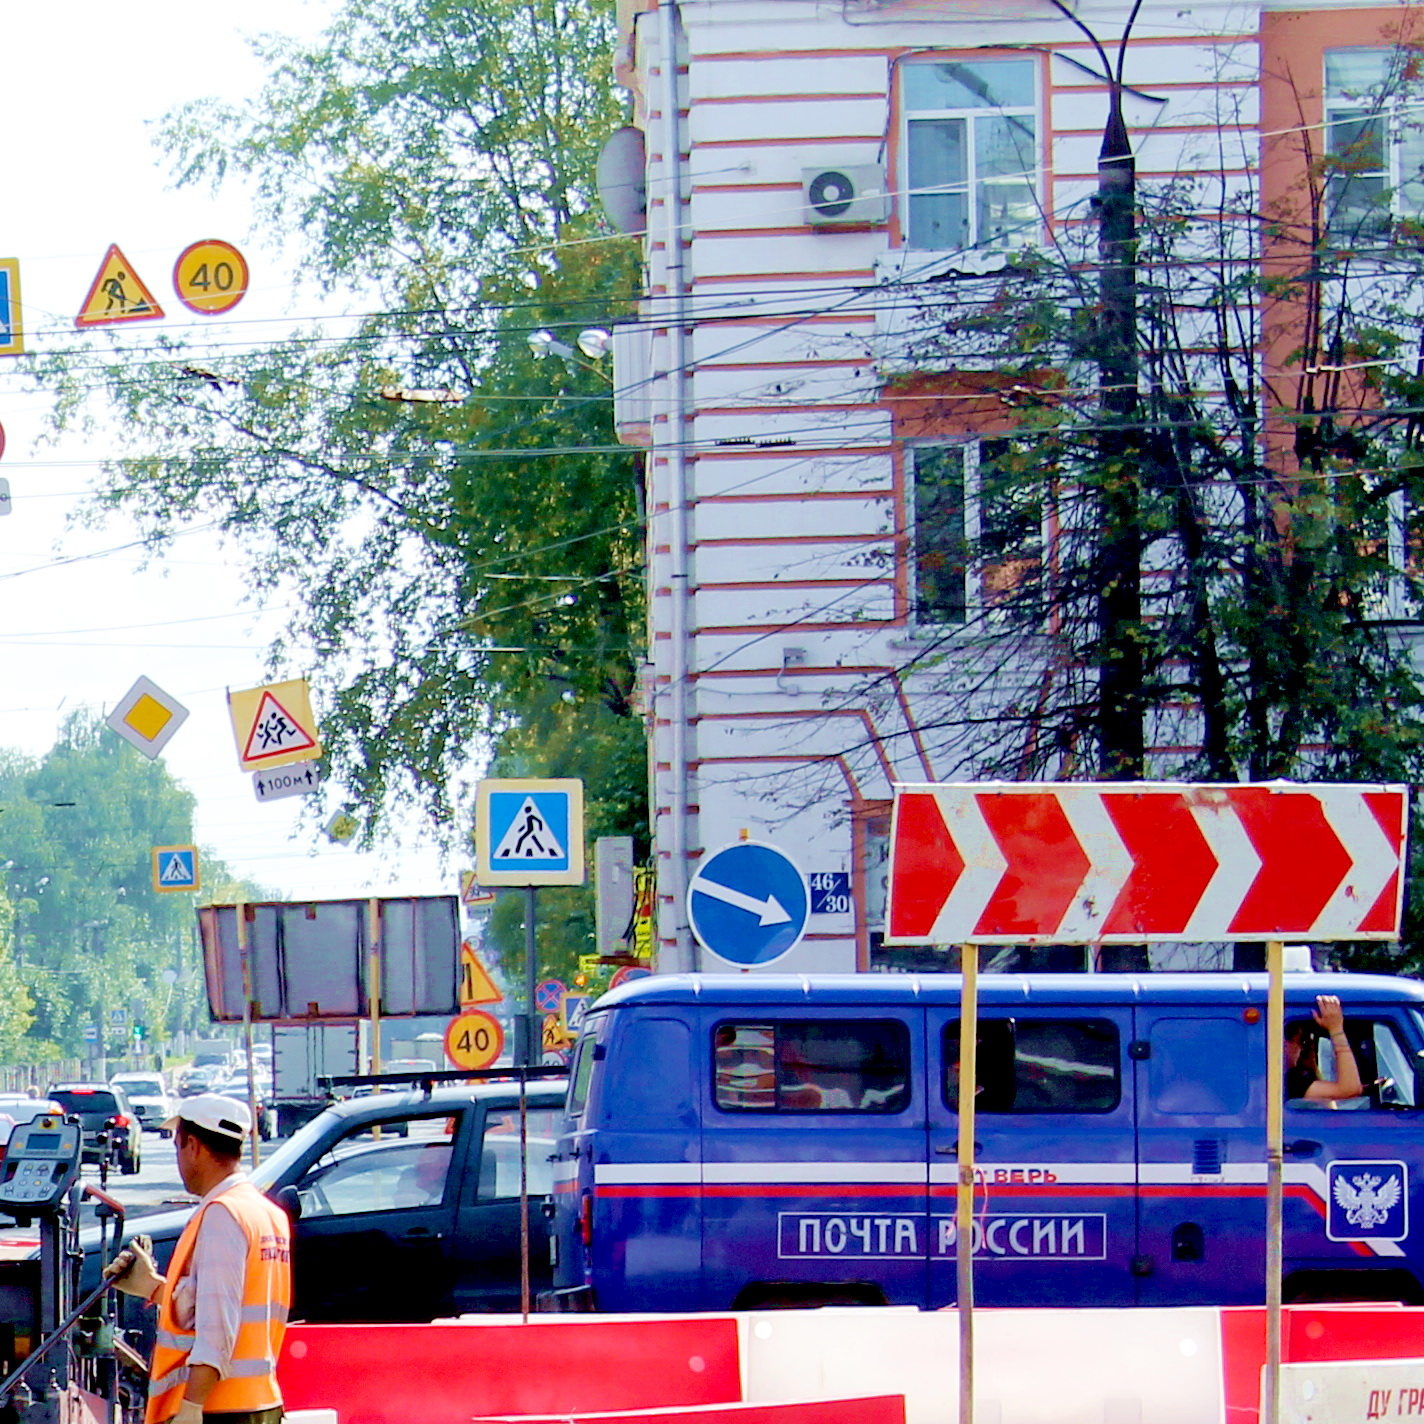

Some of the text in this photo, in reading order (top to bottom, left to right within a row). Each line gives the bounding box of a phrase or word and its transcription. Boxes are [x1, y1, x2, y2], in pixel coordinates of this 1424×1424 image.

[190, 262, 234, 292] 40
[811, 873, 834, 891] 46
[825, 895, 849, 913] 30
[457, 1028, 490, 1053] 40
[799, 1217, 918, 1253] ПОЧТА
[1366, 1389, 1392, 1420] ДУ
